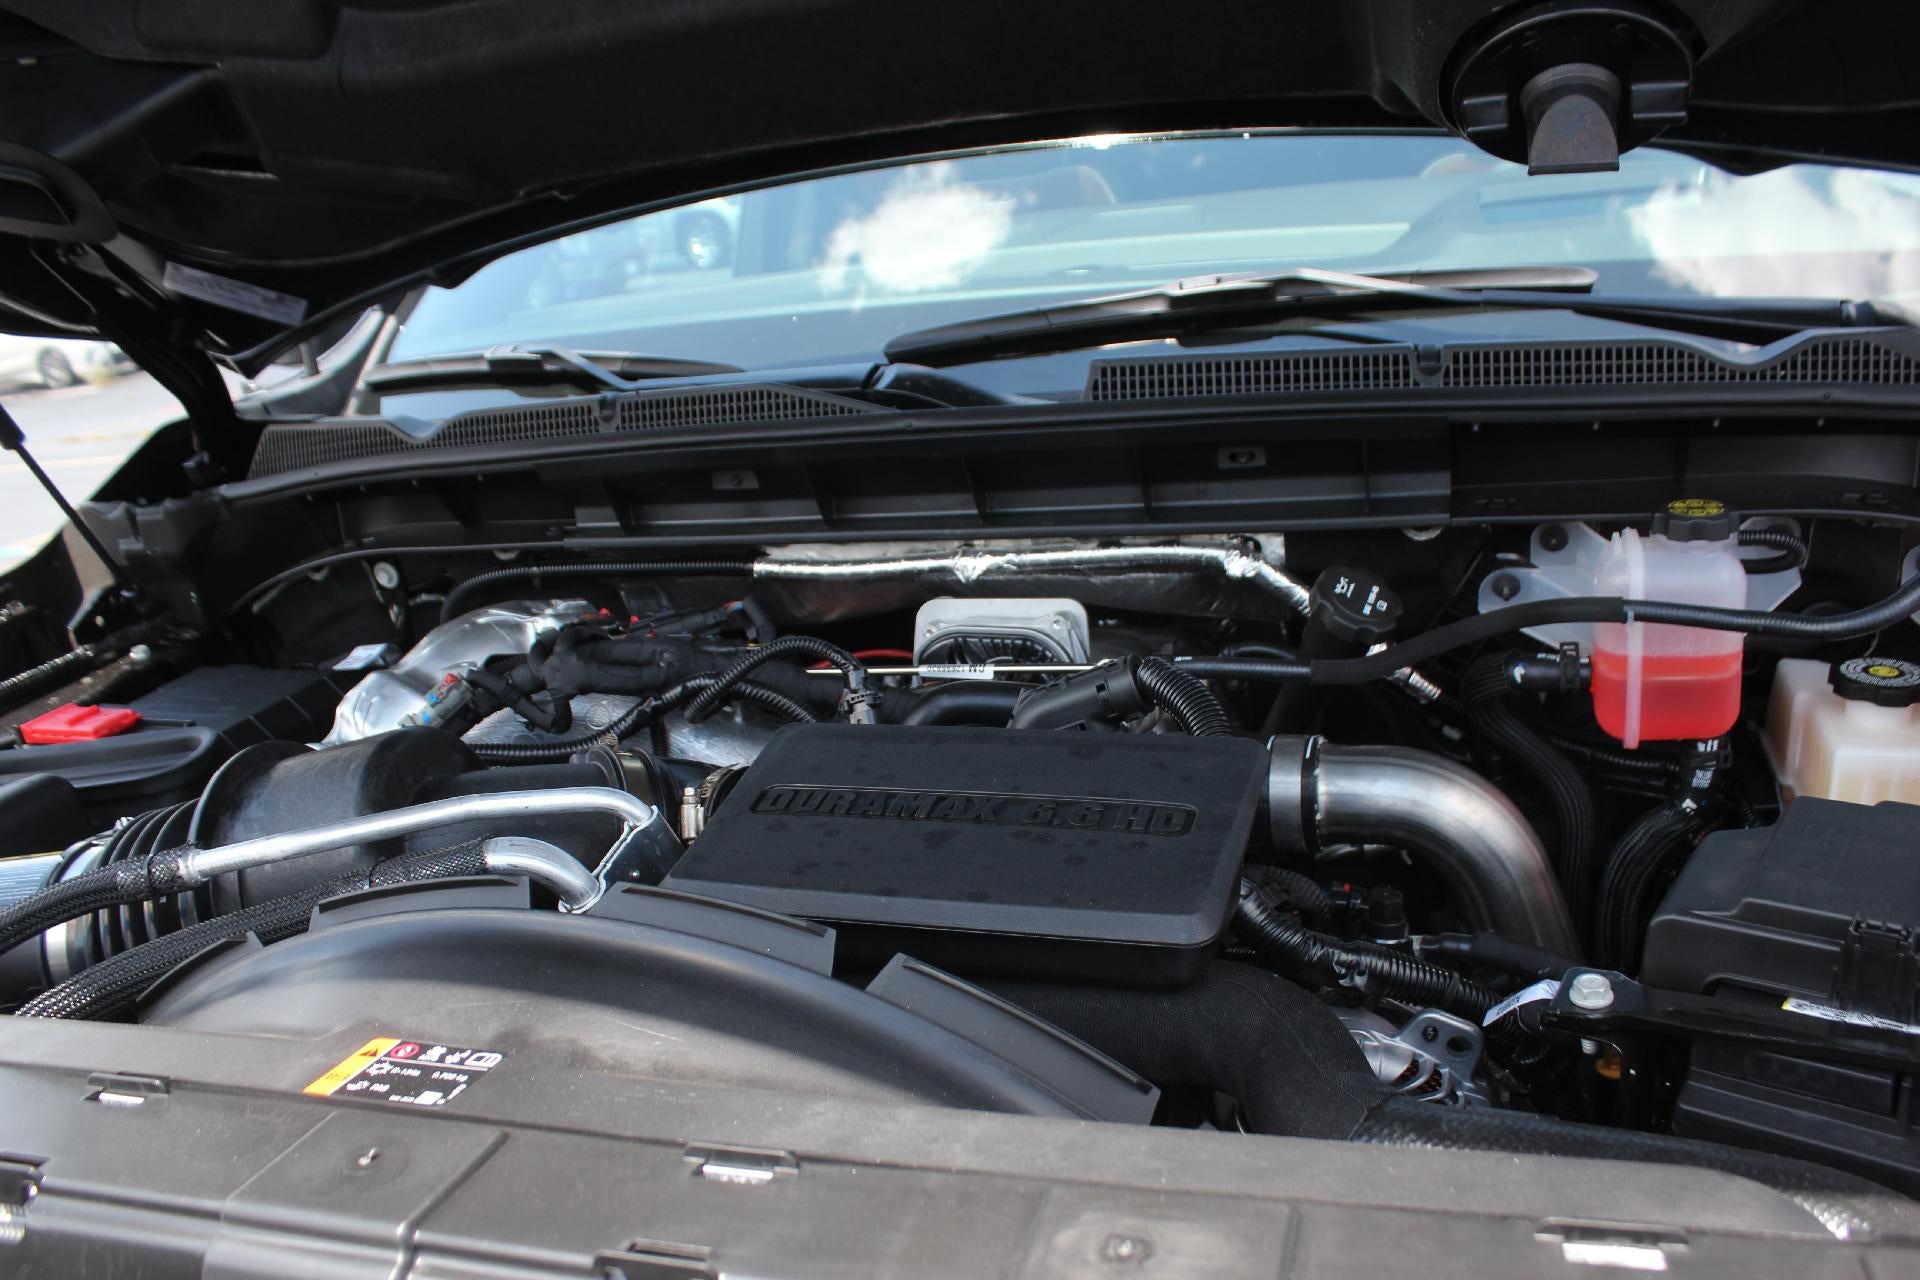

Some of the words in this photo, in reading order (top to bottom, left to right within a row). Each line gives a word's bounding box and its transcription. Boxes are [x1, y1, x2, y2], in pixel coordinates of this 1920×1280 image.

[755, 788, 1000, 822] DURAMAX
[1020, 799, 1103, 827] 6.6
[1112, 803, 1189, 834] HD
